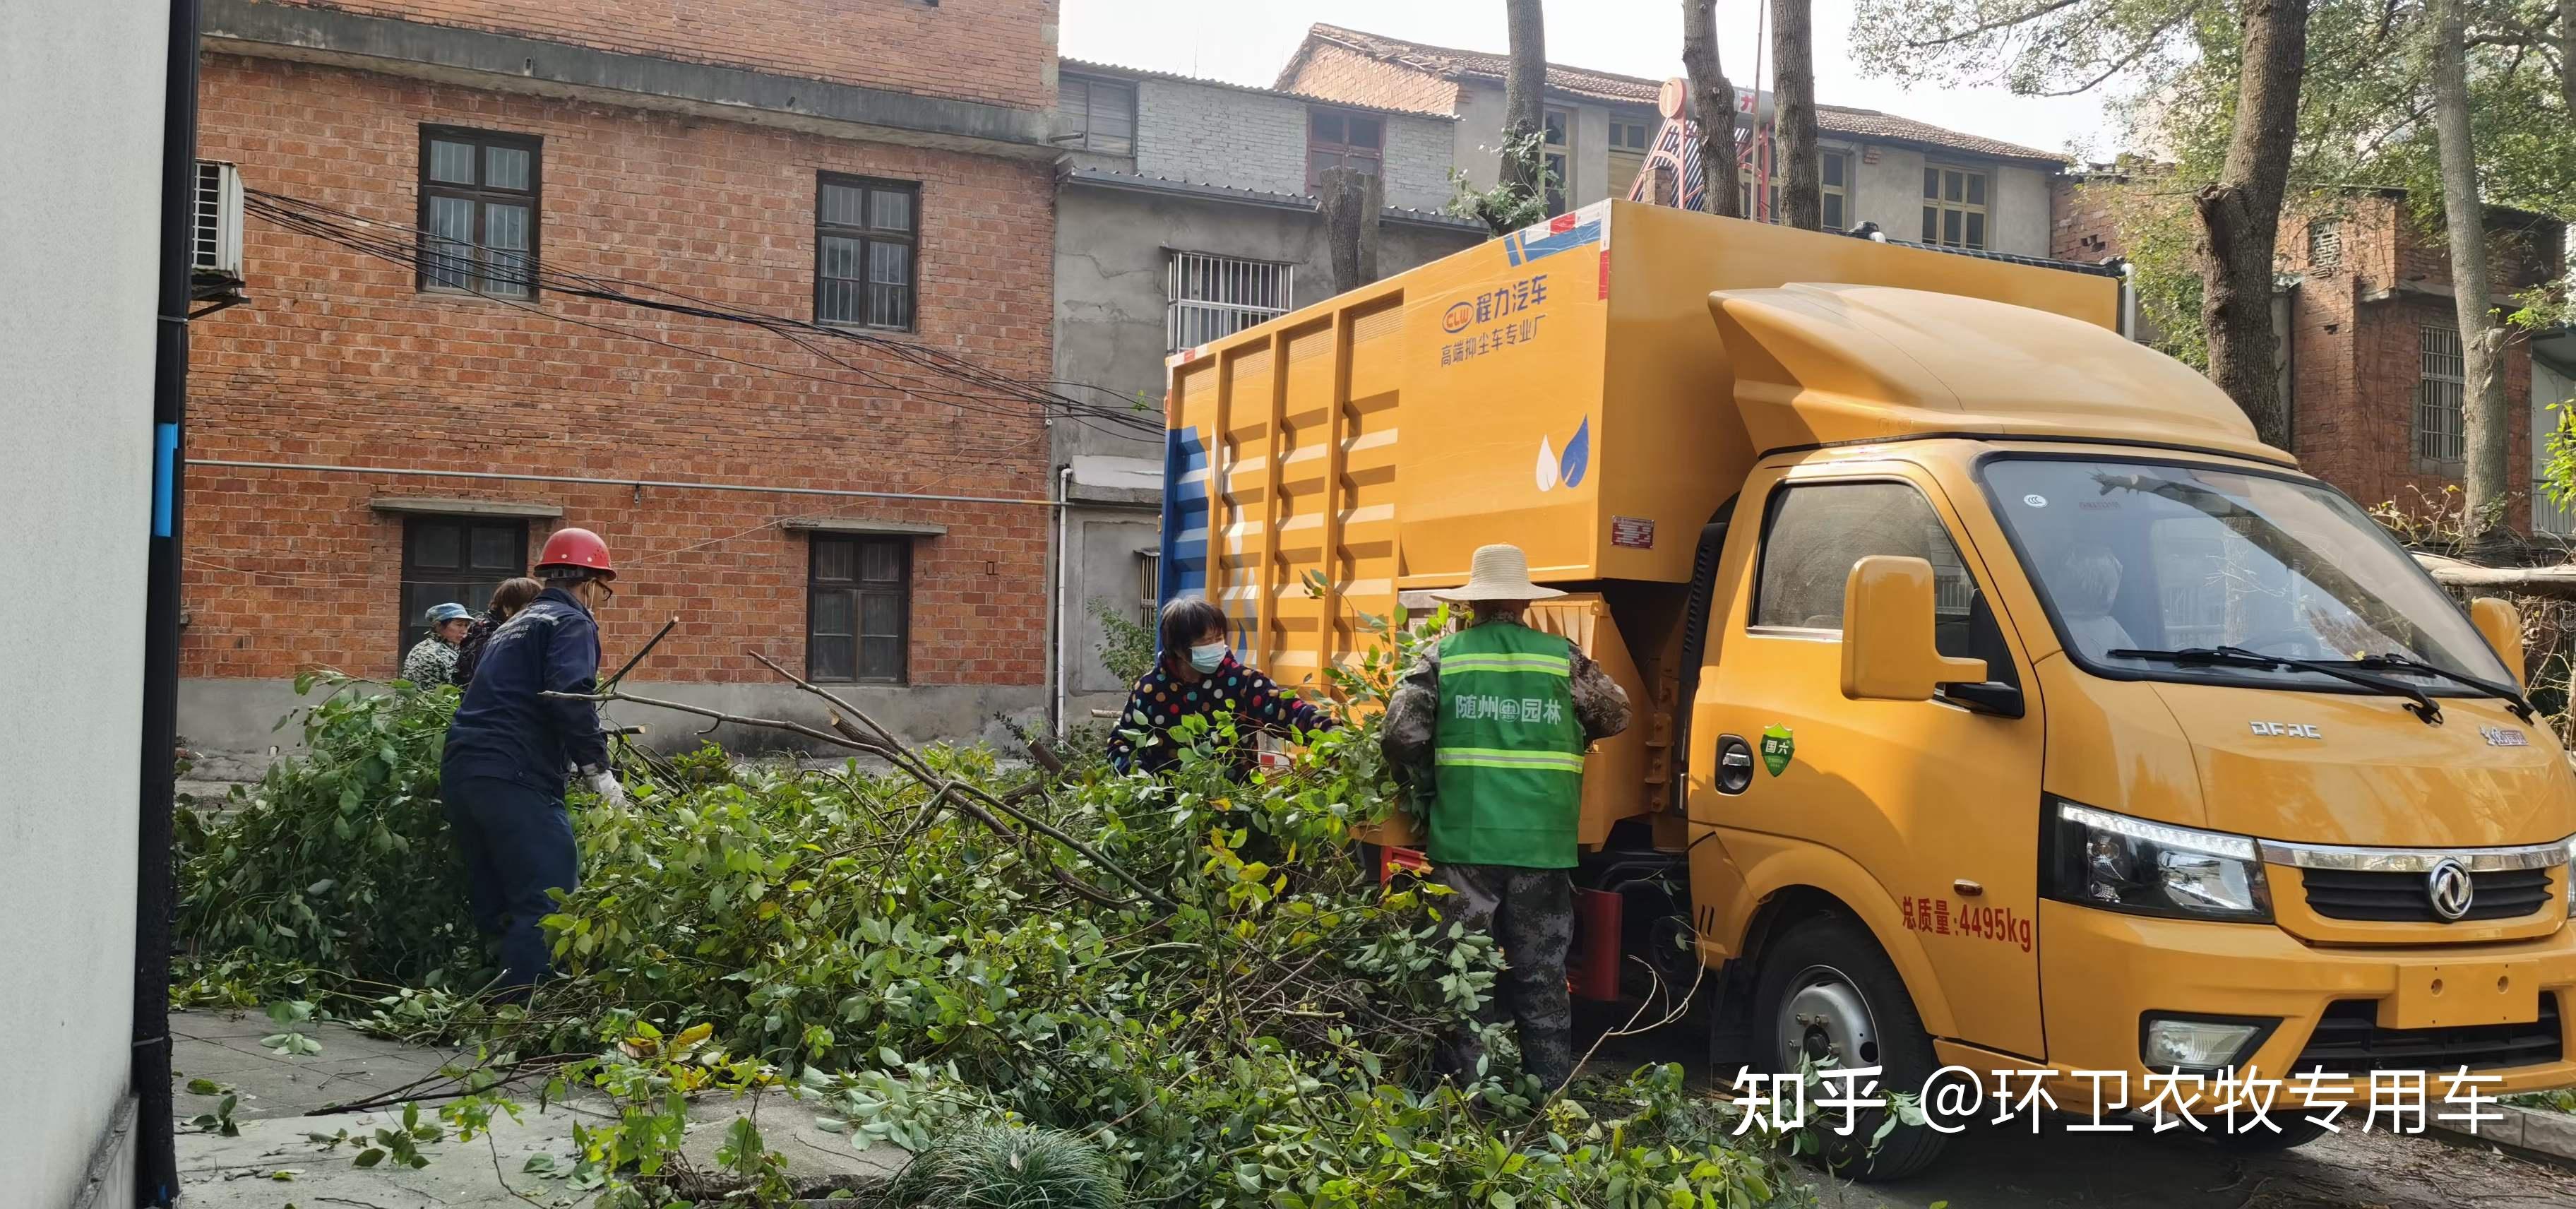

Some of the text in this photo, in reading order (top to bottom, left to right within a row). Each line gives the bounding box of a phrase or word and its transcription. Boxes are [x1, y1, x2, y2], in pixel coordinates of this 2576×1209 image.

[1445, 274, 1548, 328] CLW 程力汽车
[1441, 315, 1546, 368] 高端抑尘车专业厂
[1455, 694, 1563, 725] 随州 园林
[2248, 721, 2322, 739] DFAC
[1765, 739, 1789, 754] 国六
[1902, 896, 2032, 953] 总质量:4495kg
